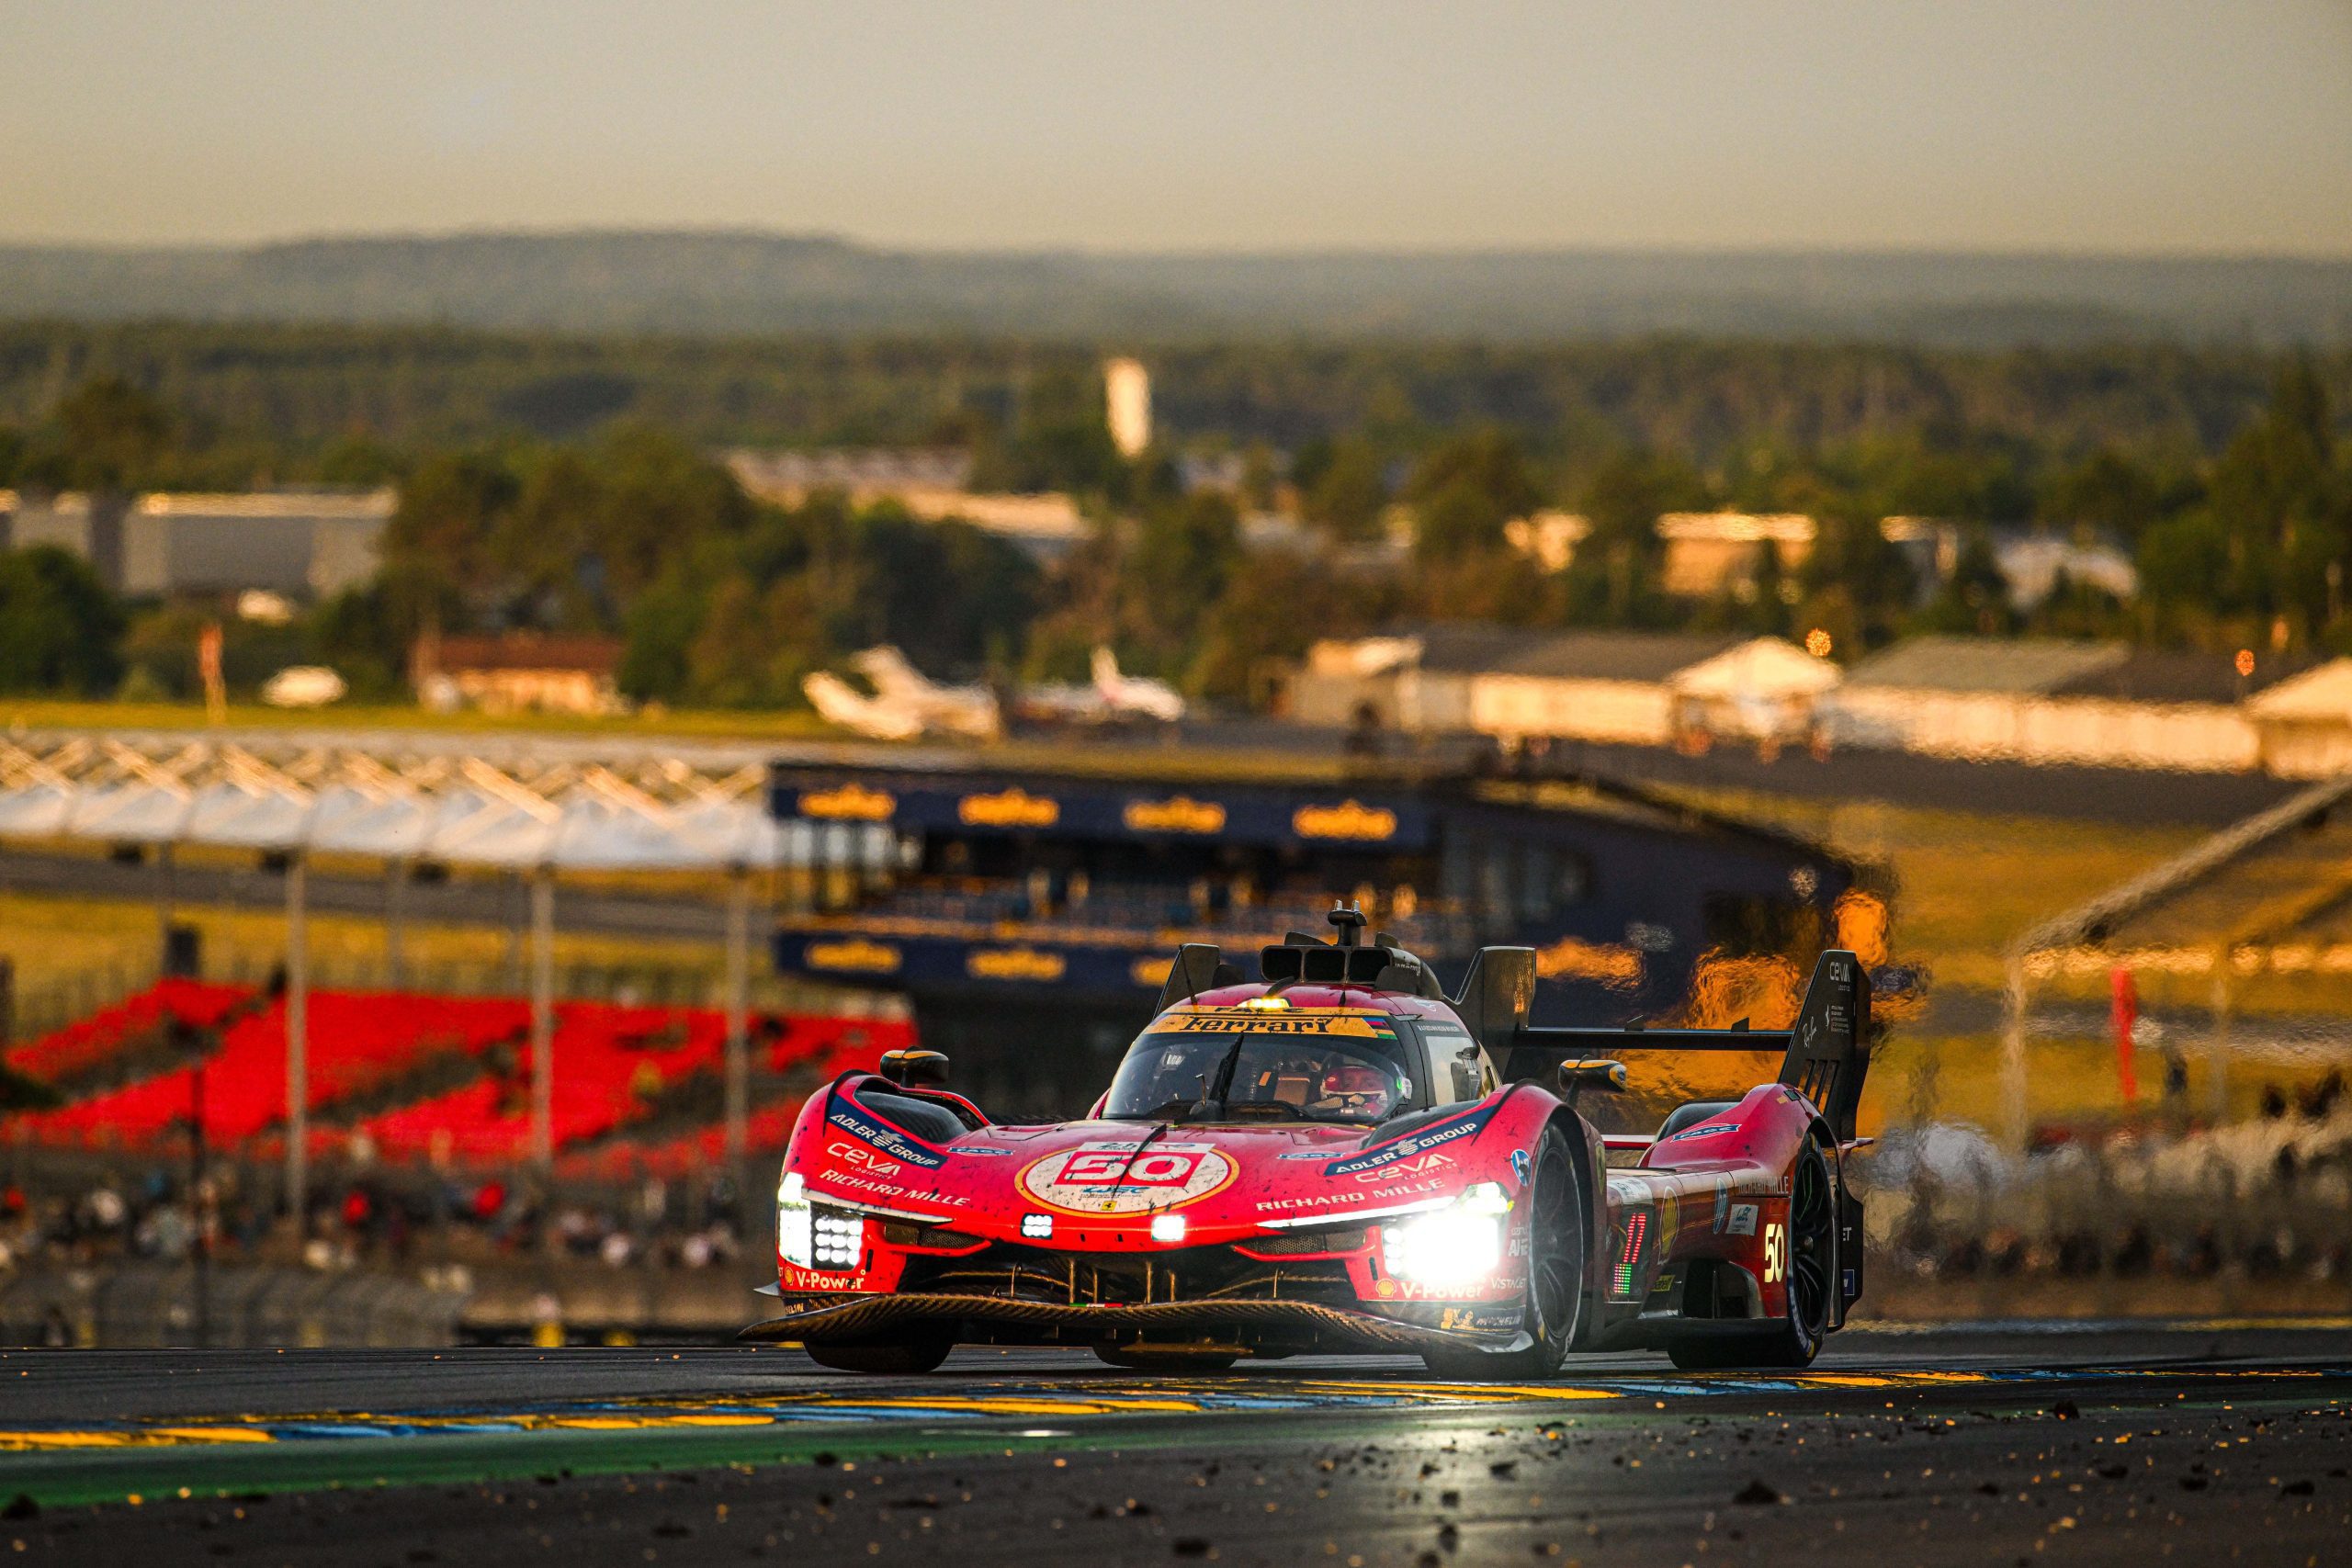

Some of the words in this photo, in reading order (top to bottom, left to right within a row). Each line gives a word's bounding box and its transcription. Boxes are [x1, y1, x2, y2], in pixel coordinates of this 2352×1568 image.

[1180, 1017, 1334, 1033] Ferrari
[830, 1113, 876, 1140] ADLER
[888, 1144, 939, 1167] GROUP
[1335, 1152, 1397, 1173] ADLER
[1417, 1122, 1477, 1148] GROUP
[851, 1165, 893, 1180] LOGISTICS
[1064, 1155, 1193, 1181] 50
[1404, 1161, 1458, 1180] LOGISTICS
[820, 1169, 904, 1196] RICHARD
[905, 1190, 971, 1206] MILLE
[1256, 1191, 1365, 1211] RICHARD
[1371, 1178, 1445, 1199] MILLE
[1764, 1223, 1785, 1283] 50
[796, 1270, 865, 1290] V-Power
[1399, 1281, 1486, 1300] V-Power
